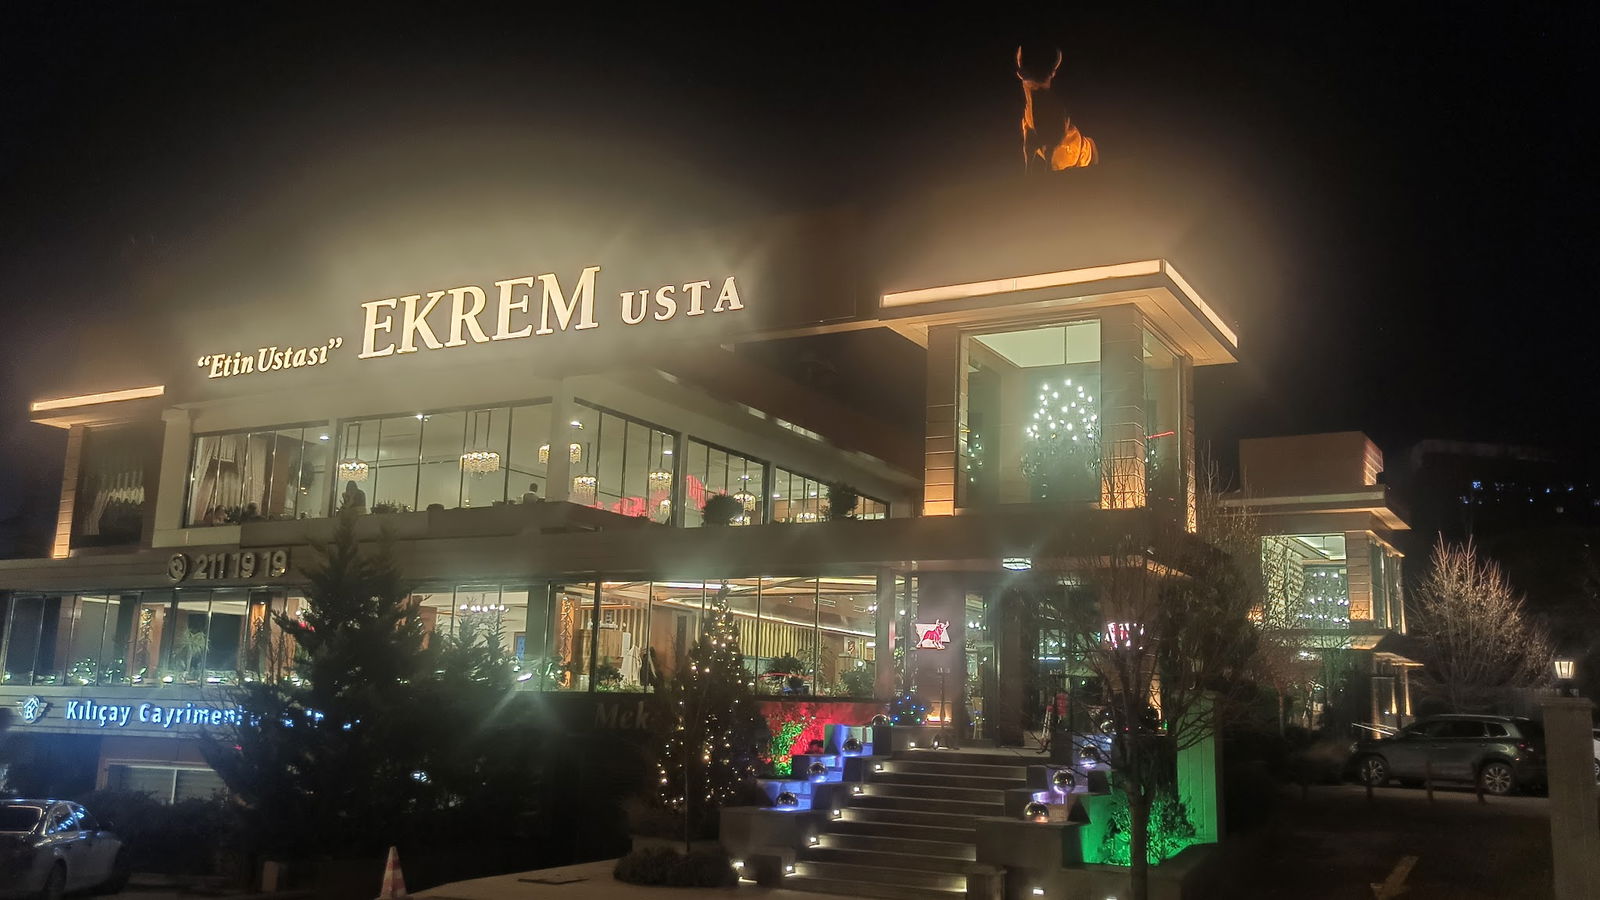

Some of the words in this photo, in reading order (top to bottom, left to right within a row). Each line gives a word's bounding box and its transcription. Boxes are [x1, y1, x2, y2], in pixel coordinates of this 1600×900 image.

[357, 265, 601, 360] EKREM
[620, 276, 744, 325] USTA
[193, 554, 226, 580] 211
[233, 552, 255, 578] 19
[264, 550, 287, 577] 19
[66, 700, 131, 727] Kılıçay
